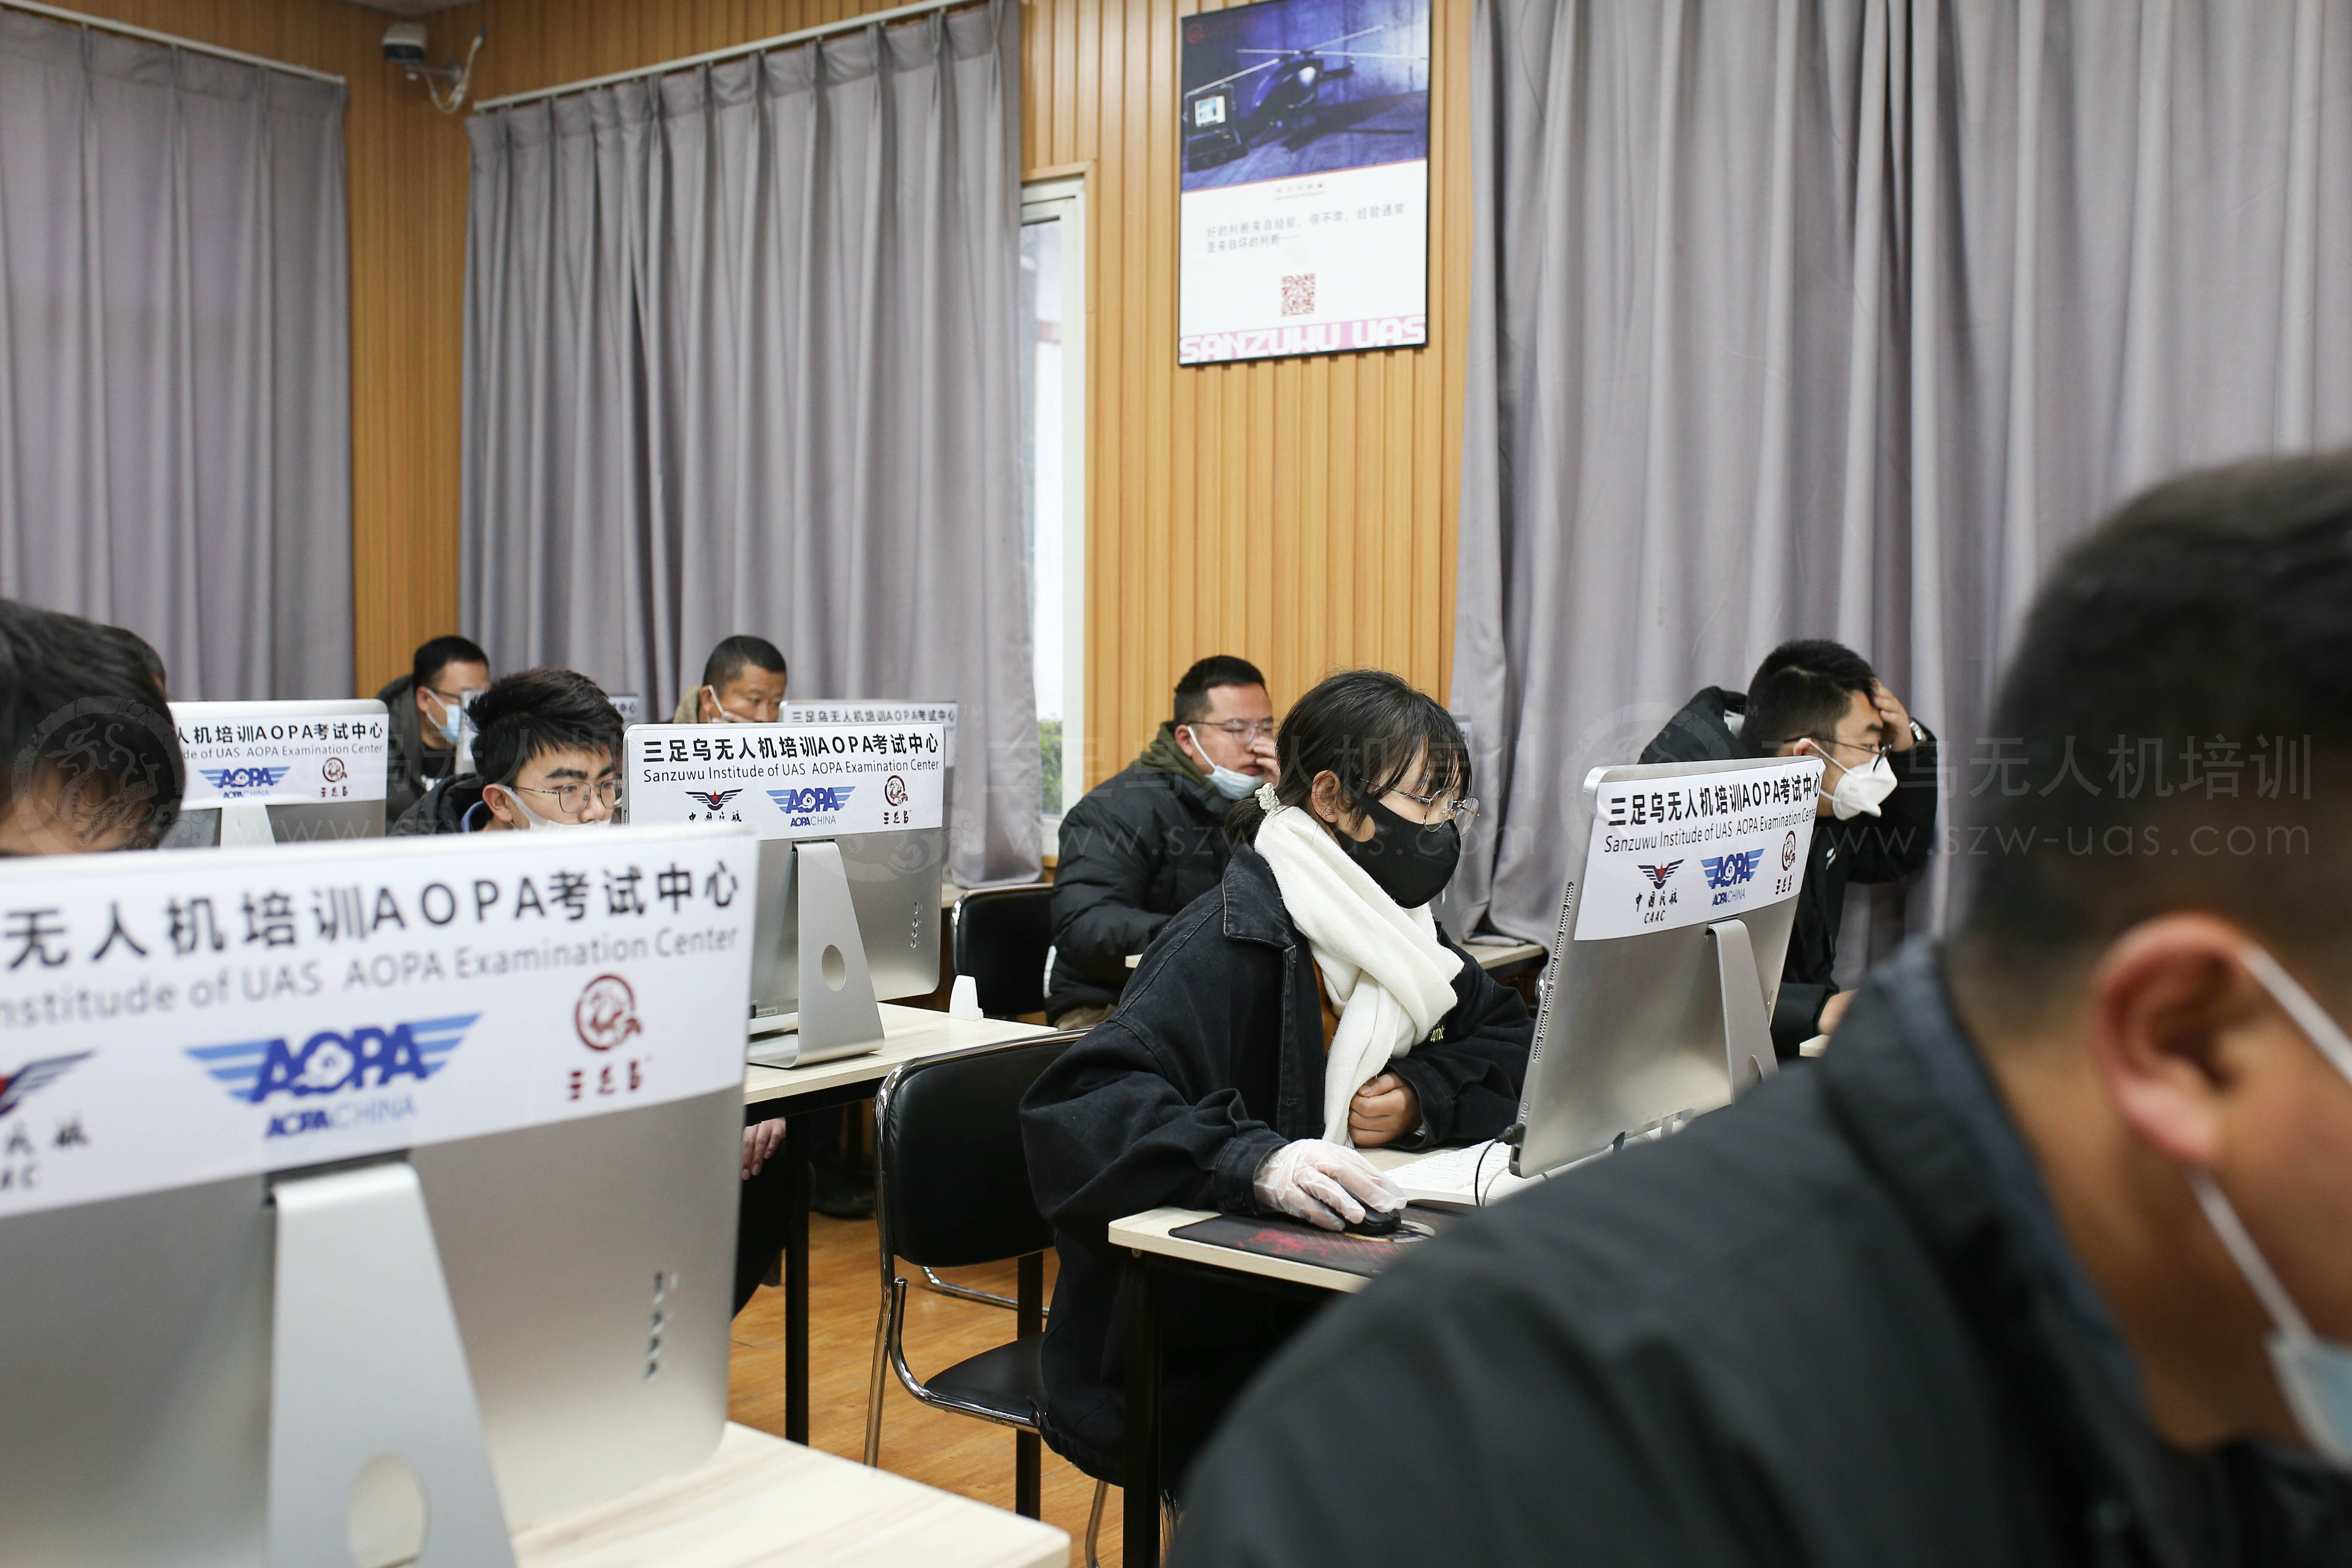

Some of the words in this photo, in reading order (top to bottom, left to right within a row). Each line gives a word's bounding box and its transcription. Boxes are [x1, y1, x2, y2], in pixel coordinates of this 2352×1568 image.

[1179, 322, 1341, 364] SANZUWU
[1351, 315, 1426, 349] UAS
[201, 748, 212, 759] of
[216, 747, 240, 758] UAS
[247, 746, 279, 756] AOPA
[282, 744, 349, 756] Examination
[352, 743, 383, 753] Center
[644, 733, 938, 763] 三足乌无人机培训AOPA考试中心
[218, 768, 273, 788] AOPA
[644, 769, 705, 782] Sanzuwu
[709, 765, 764, 779] Institude
[768, 763, 779, 776] of
[782, 763, 805, 775] UAS
[812, 762, 842, 774] AOPA
[846, 759, 908, 773] Examination
[910, 759, 939, 770] Center
[785, 787, 840, 814] AOPA
[1608, 772, 1820, 826] 三足乌无人机培训AOPA考试中心
[1605, 836, 1657, 852] Sanzuwu
[1660, 826, 1702, 848] Institude
[1705, 823, 1715, 841] of
[1715, 821, 1733, 839] UAS
[1736, 817, 1758, 836] AOPA
[1761, 810, 1801, 831] Examination
[1802, 808, 1816, 822] Cente
[1711, 852, 1750, 889] AOPA
[4, 860, 739, 971] 无人机培训AOPA考试中心
[1645, 910, 1666, 924] CAAC
[188, 966, 229, 1008] of
[242, 960, 322, 1001] UAS
[343, 952, 446, 990] AOPA
[456, 932, 649, 979] Examination
[655, 927, 738, 958] Center
[251, 1023, 429, 1103] AOPA
